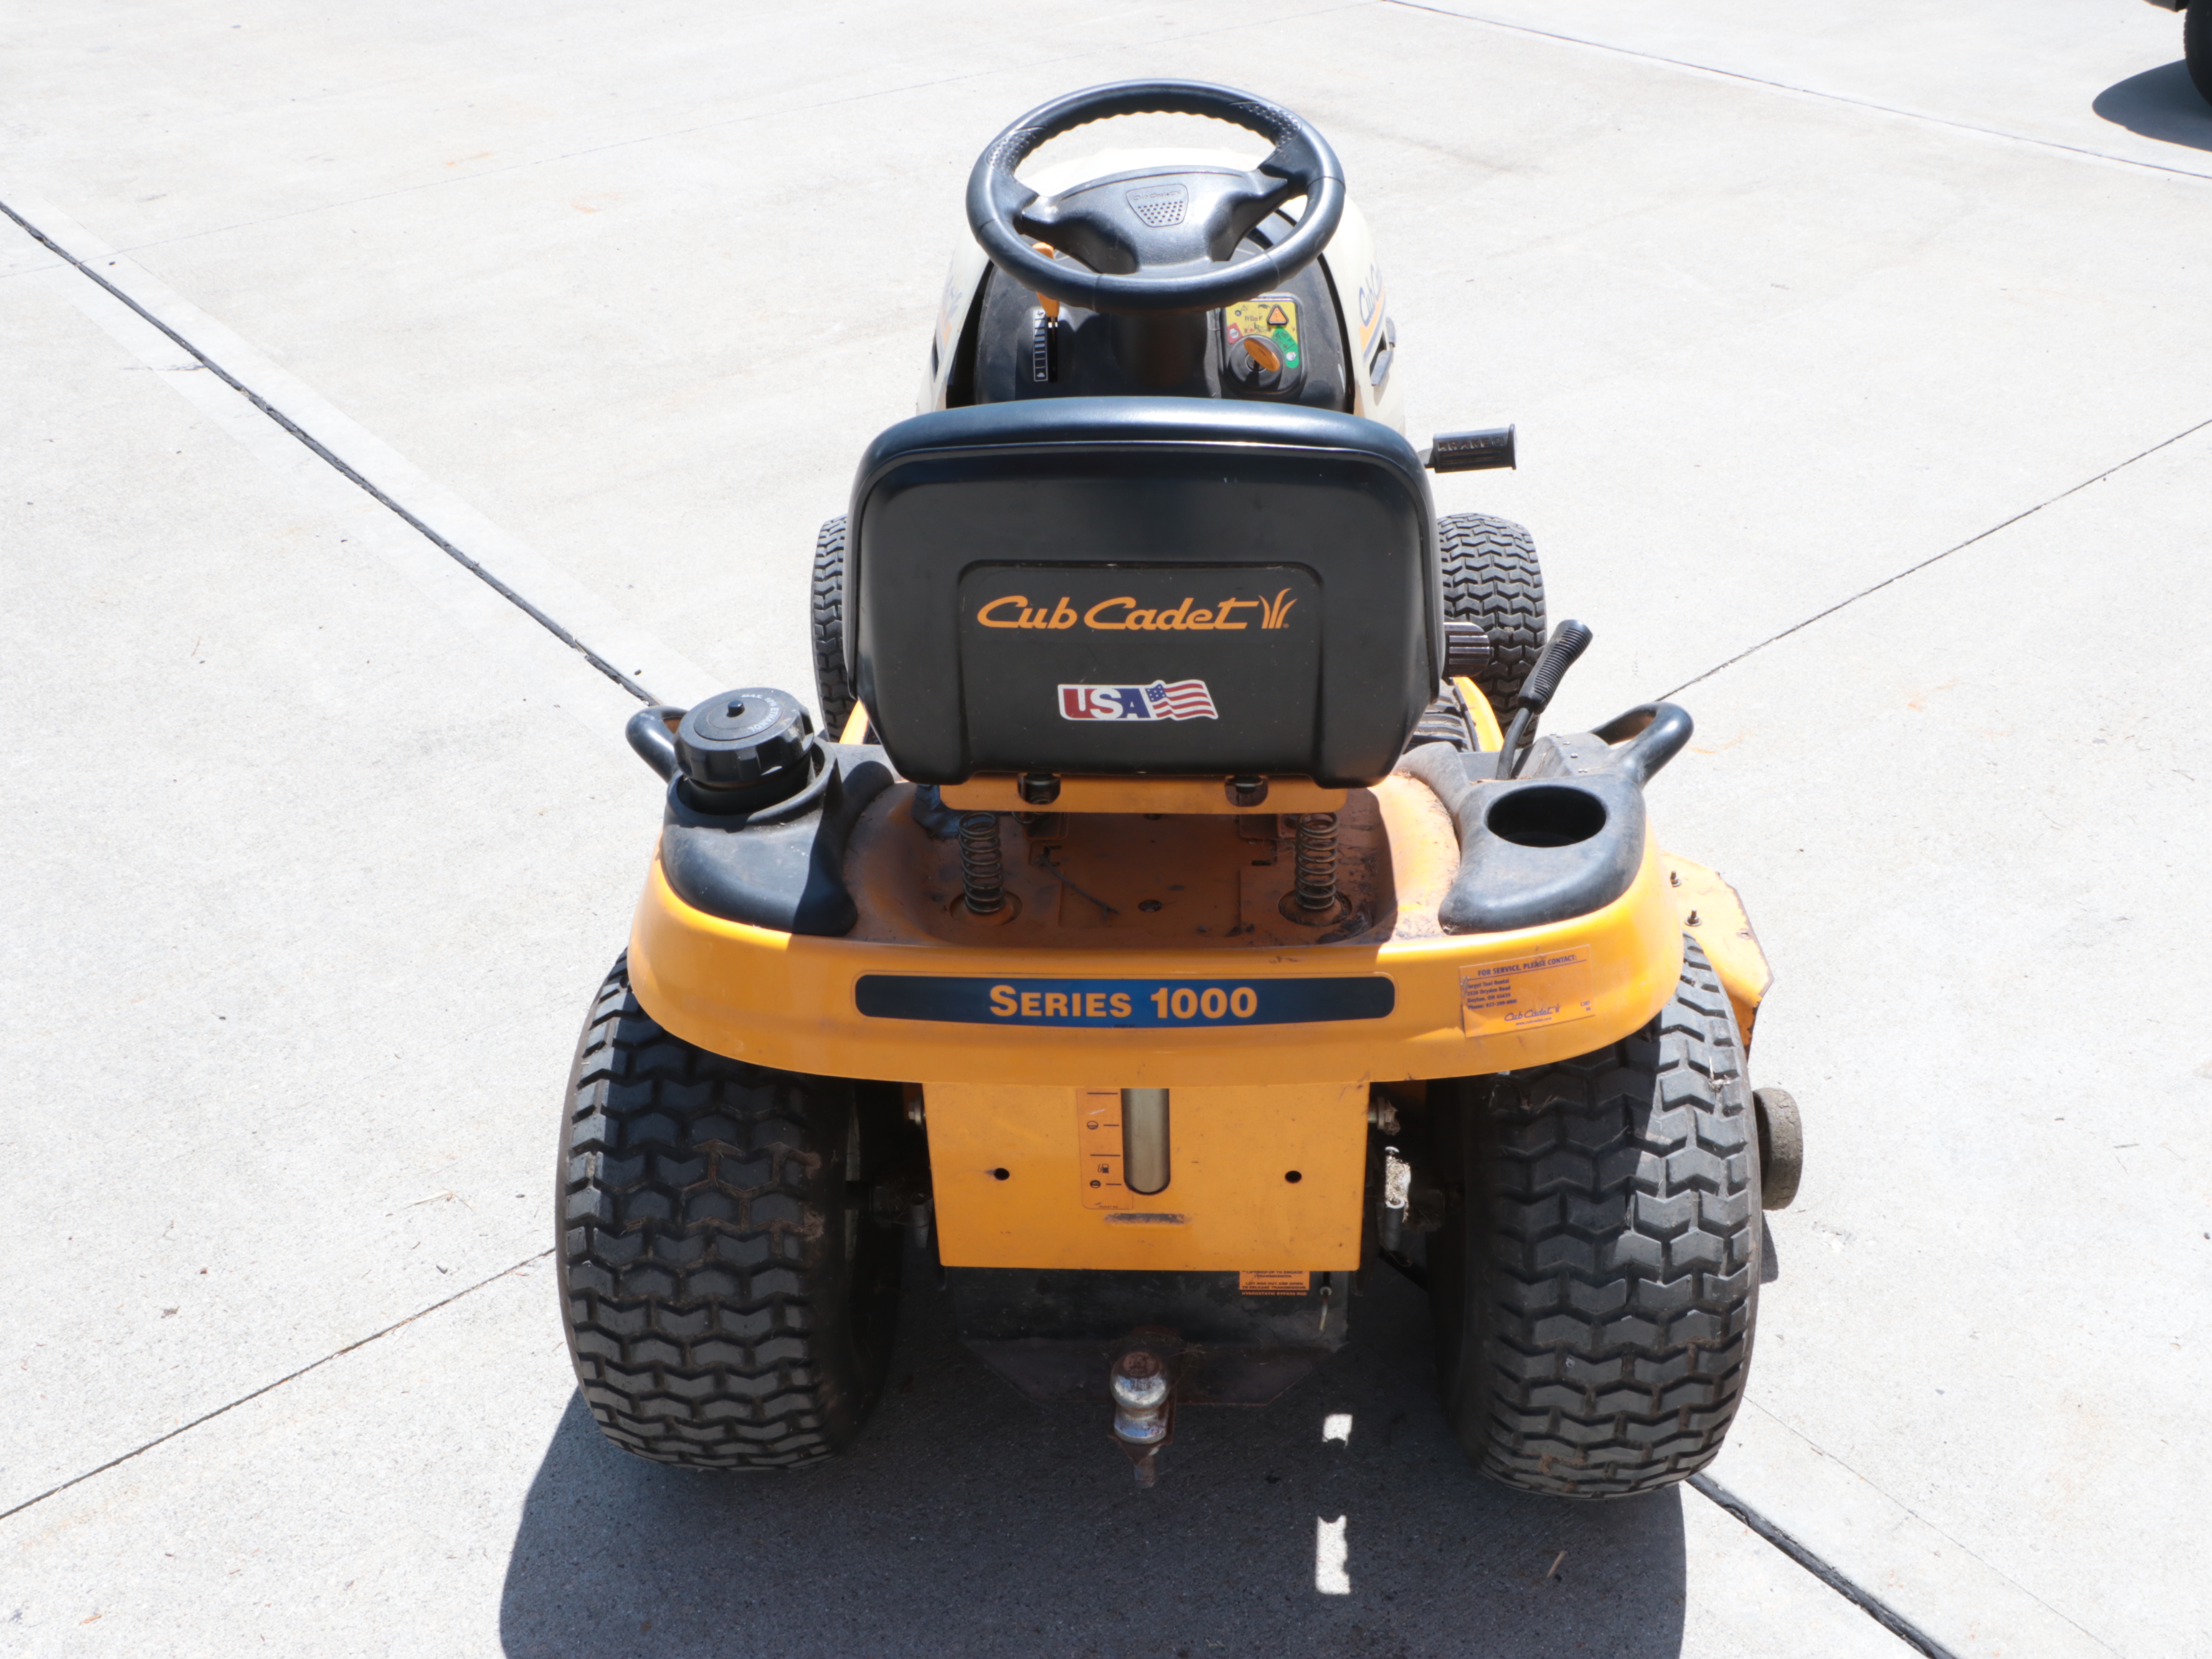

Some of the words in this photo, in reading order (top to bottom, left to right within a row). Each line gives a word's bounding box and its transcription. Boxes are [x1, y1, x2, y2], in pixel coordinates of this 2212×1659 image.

[1437, 438, 1489, 451] BRAKE
[977, 595, 1077, 629] Cub
[1084, 597, 1259, 630] Cadet
[1062, 688, 1151, 719] USA
[747, 707, 779, 732] ETHANOL
[1493, 965, 1521, 975] SERVICE,
[1523, 960, 1546, 970] PLEASE
[1548, 955, 1577, 965] CONTACT:
[1150, 987, 1257, 1018] 1000
[1504, 1011, 1523, 1021] Cub
[1524, 1006, 1554, 1018] Cadet
[1516, 1017, 1552, 1026] www.cubcadet.com
